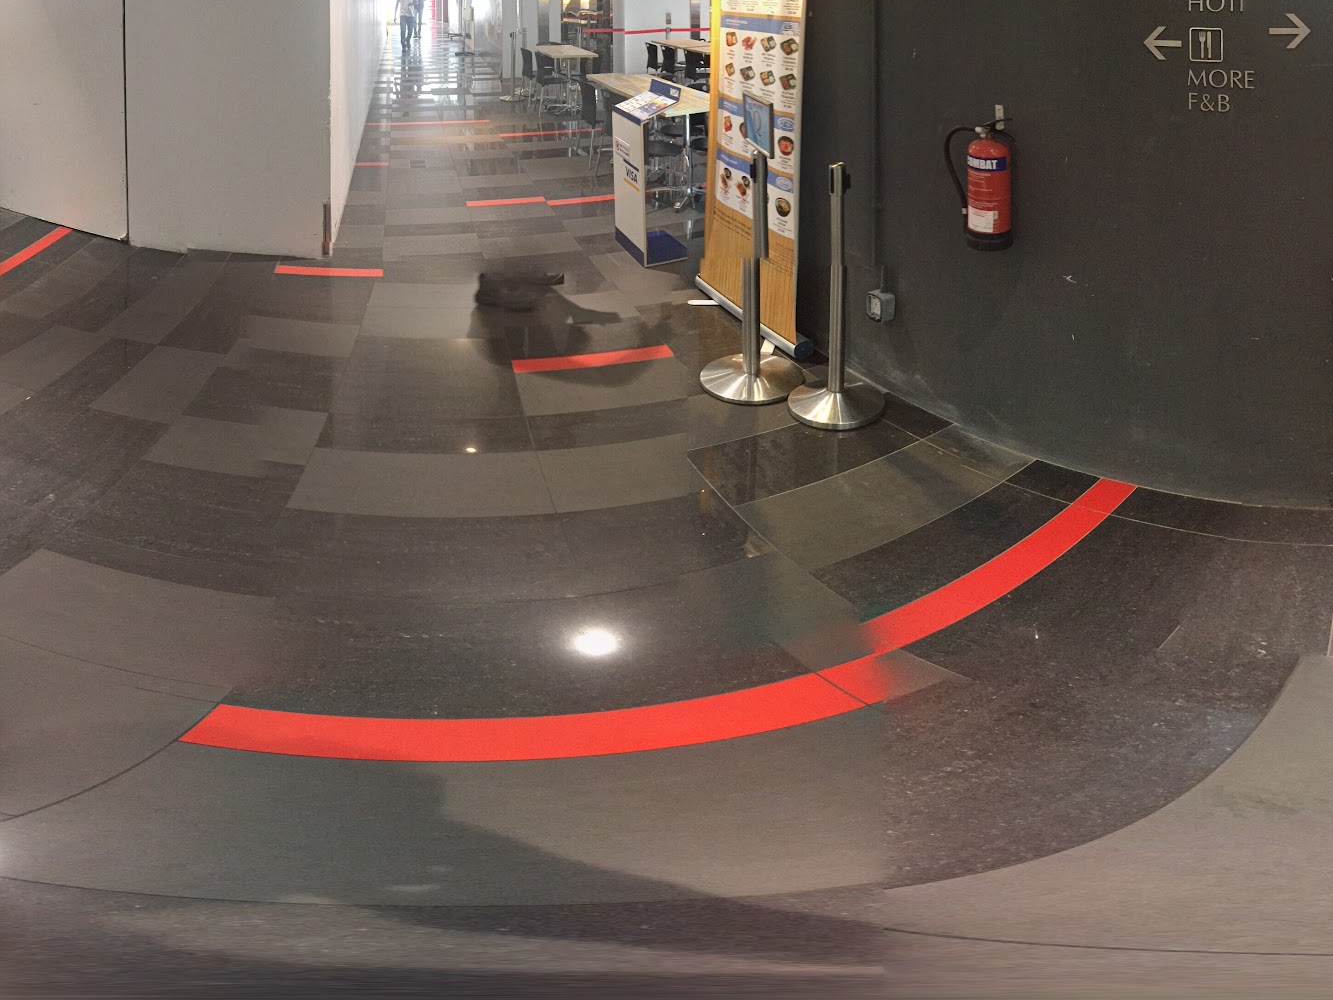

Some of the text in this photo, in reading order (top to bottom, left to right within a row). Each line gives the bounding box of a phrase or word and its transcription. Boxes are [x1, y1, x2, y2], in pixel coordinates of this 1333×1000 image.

[1188, 69, 1254, 89] MORE
[1188, 92, 1230, 112] F&B
[625, 166, 638, 184] VISA
